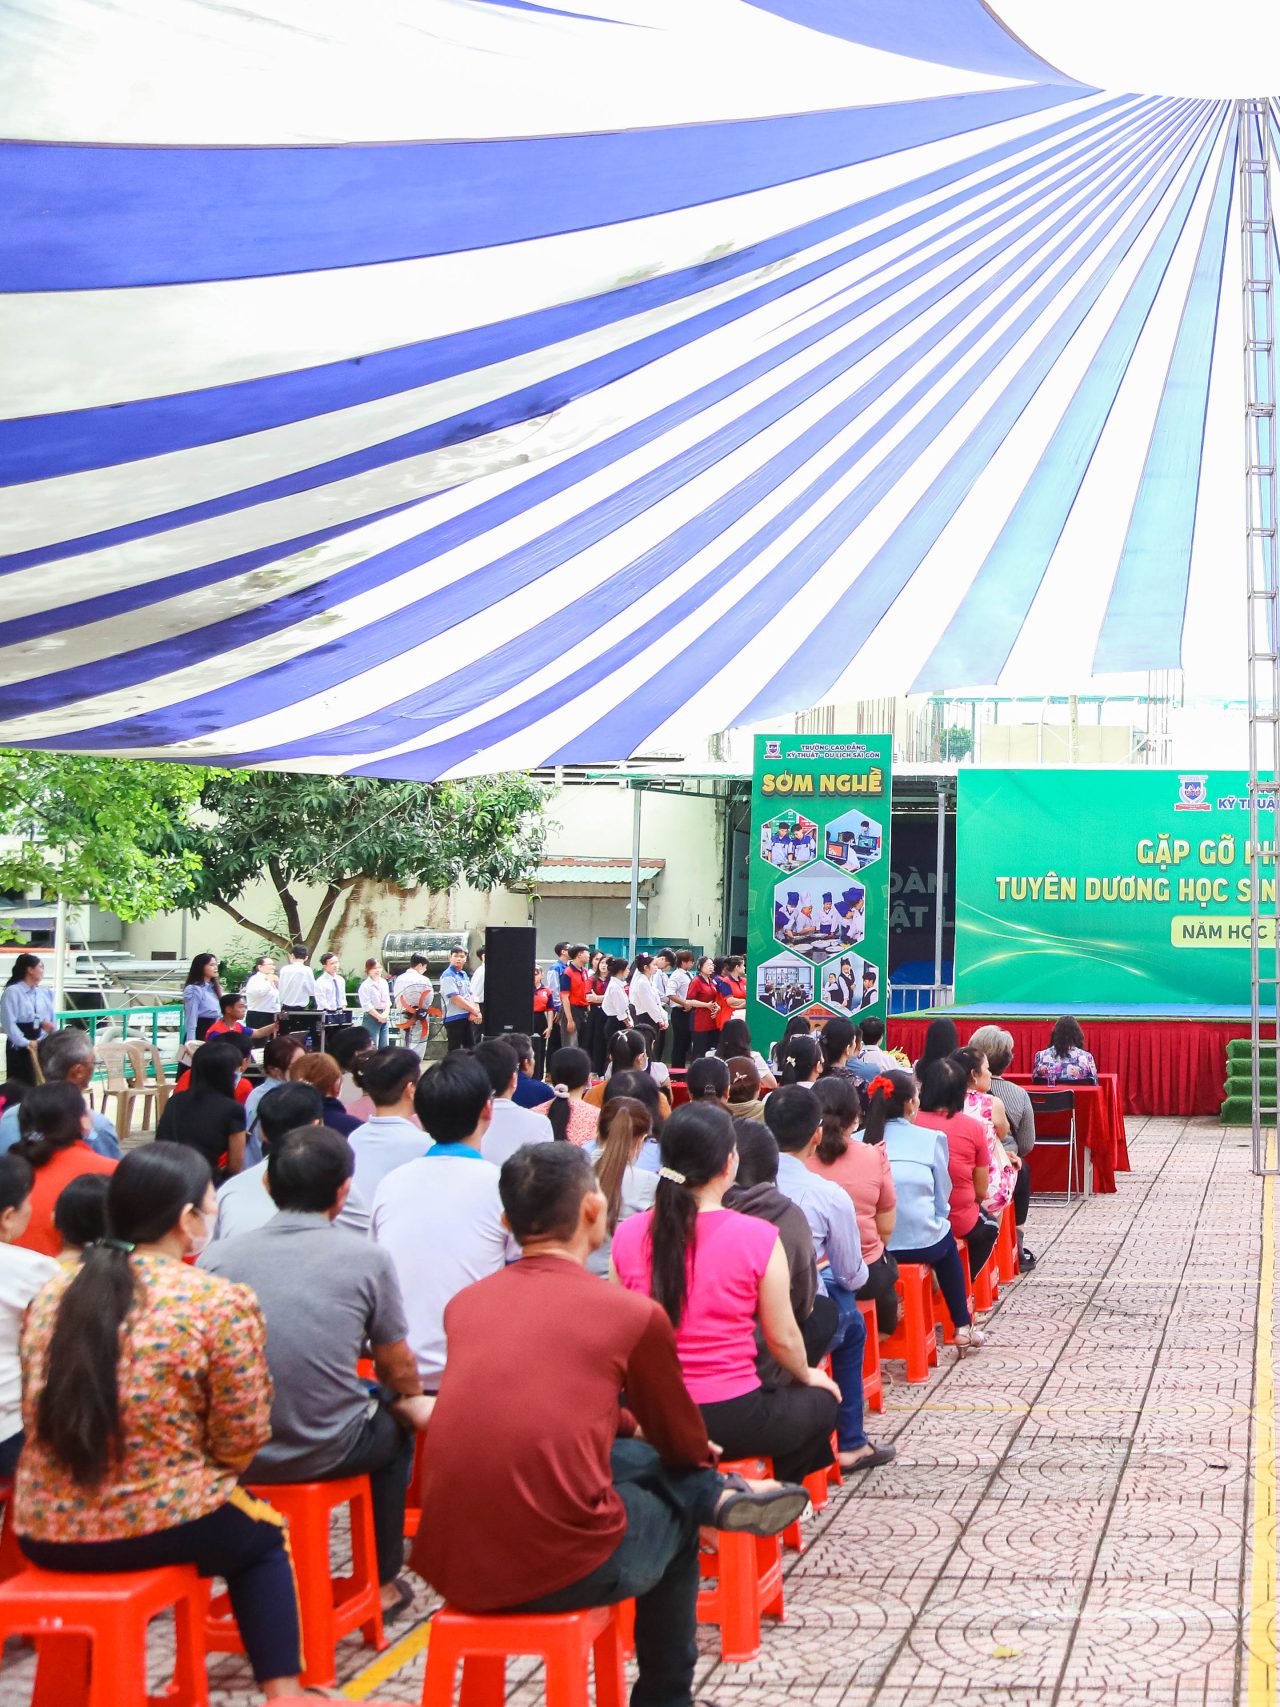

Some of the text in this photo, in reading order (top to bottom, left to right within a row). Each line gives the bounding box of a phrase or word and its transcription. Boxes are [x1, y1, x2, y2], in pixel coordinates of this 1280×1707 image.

[762, 767, 882, 794] SỚM NGHỀ
[1218, 796, 1236, 809] KỸ
[1137, 833, 1191, 871] GẶP
[995, 871, 1077, 901] TUYÊN
[1085, 875, 1170, 902] DƯƠNG
[1179, 878, 1229, 908] HỌC
[1182, 921, 1222, 939] NĂM
